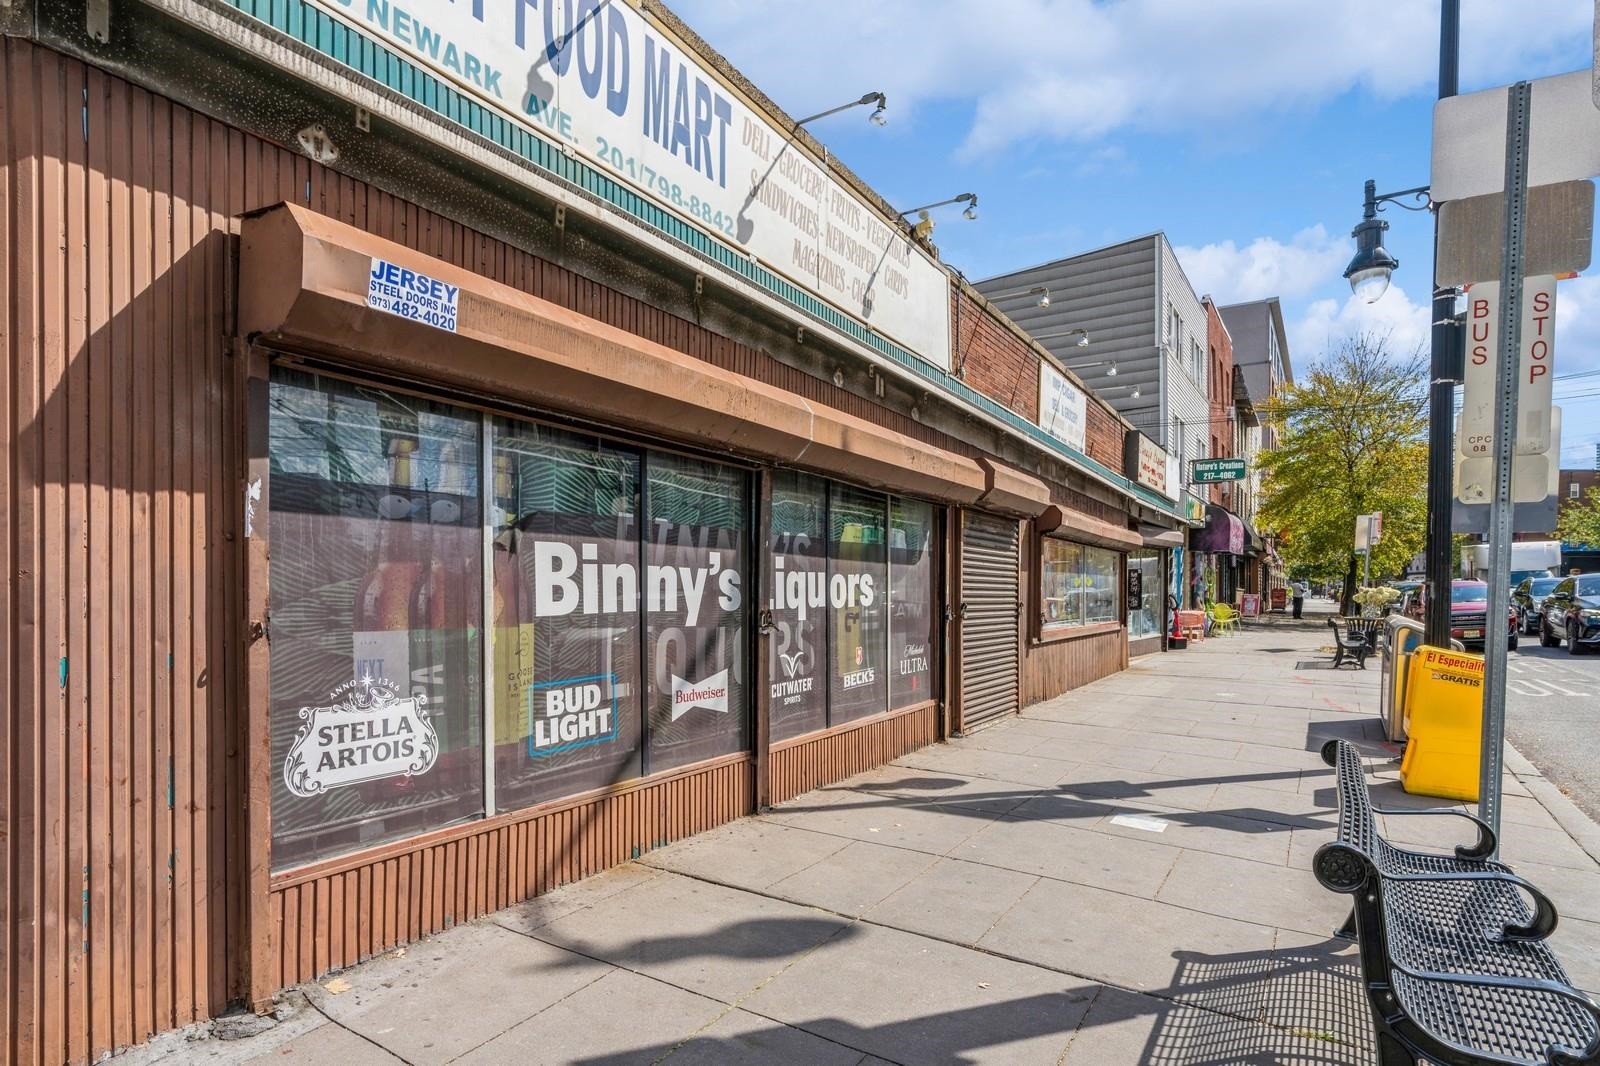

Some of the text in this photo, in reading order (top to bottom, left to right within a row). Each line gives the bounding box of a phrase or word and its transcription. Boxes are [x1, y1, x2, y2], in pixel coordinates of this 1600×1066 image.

[366, 0, 503, 99] NEWARK
[527, 93, 579, 144] AVE.
[643, 34, 732, 189] MART
[742, 116, 771, 162] DELI
[830, 189, 861, 232] FRUITS
[370, 280, 456, 316] STEEL DOORS INC
[372, 261, 457, 303] JERSEY
[368, 294, 455, 331] (973) 482-4020
[1472, 292, 1549, 384] BUS STOP
[1468, 435, 1492, 444] CPC
[1473, 445, 1486, 453] 08
[534, 541, 873, 626] Binny's iquors
[900, 658, 928, 675] ULTRA
[1427, 652, 1436, 663] El
[329, 677, 401, 700] ANNO 1366
[772, 678, 813, 698] CUTWATER
[843, 669, 875, 688] BECK'S
[1440, 673, 1480, 687] GRATIS
[546, 684, 601, 717] BUD
[784, 696, 801, 705] SPIRITS
[318, 716, 414, 747] STELLA
[535, 708, 611, 748] LIGHT
[316, 738, 415, 773] ARTOIS
